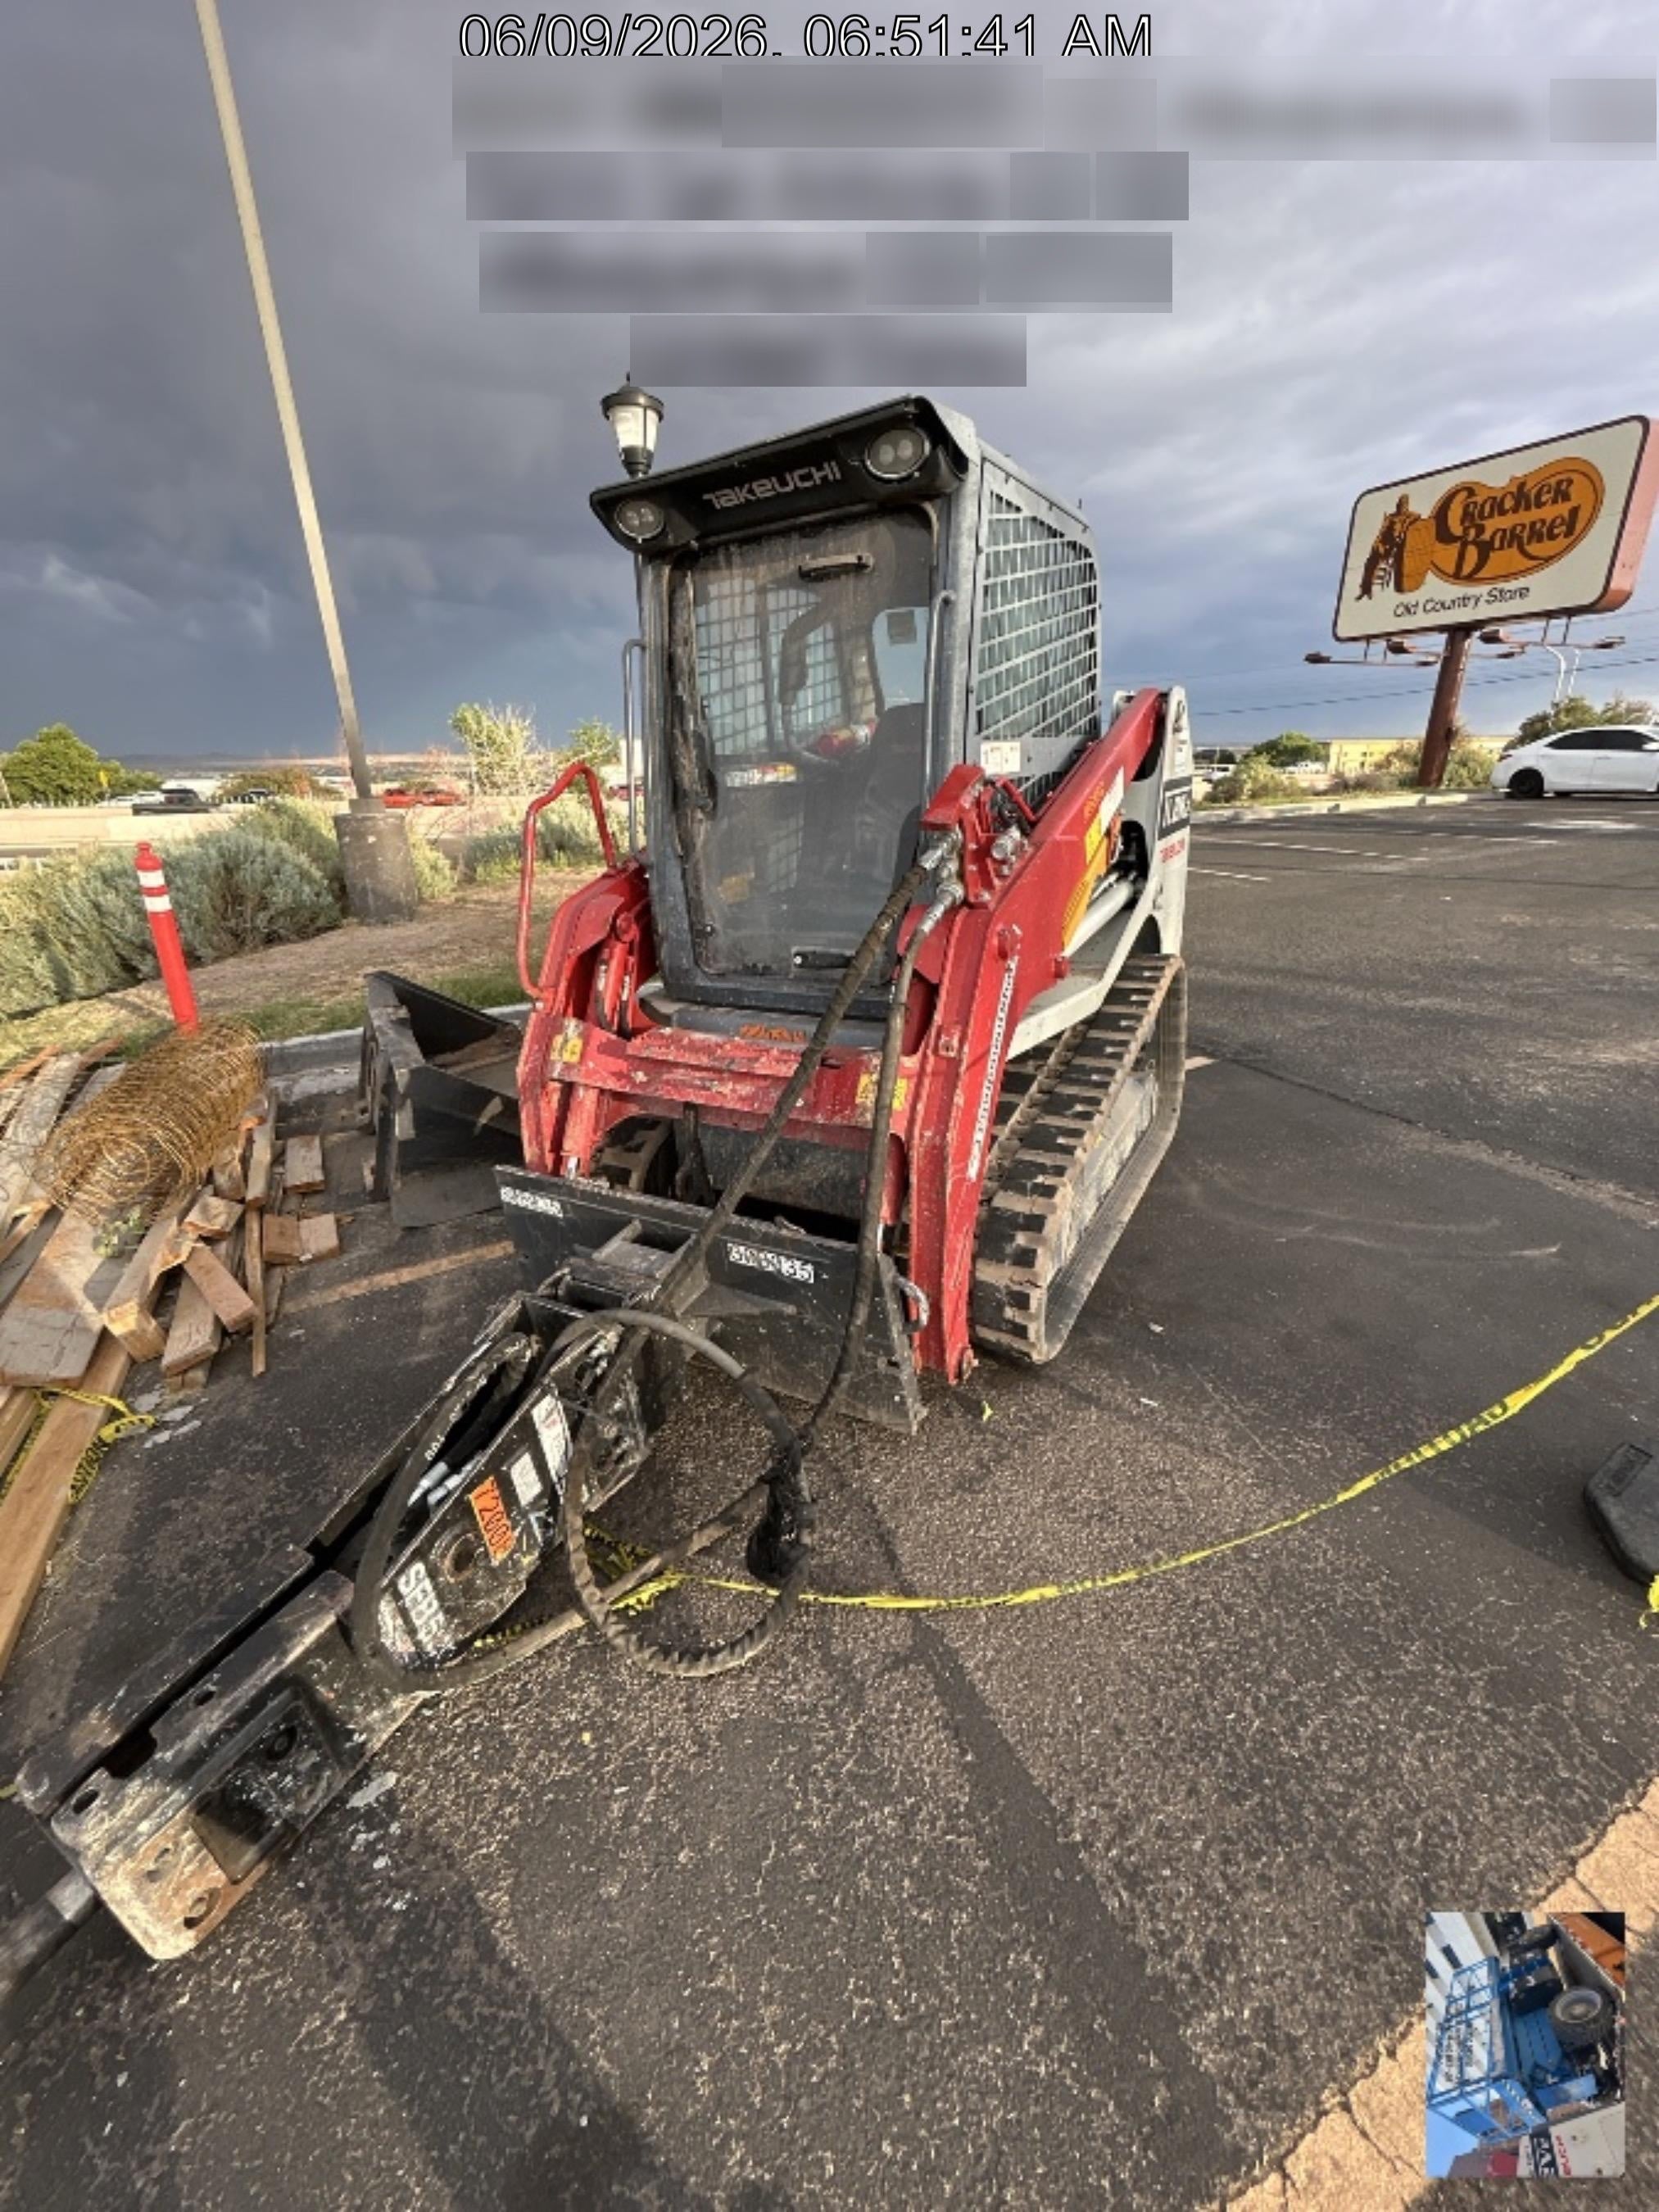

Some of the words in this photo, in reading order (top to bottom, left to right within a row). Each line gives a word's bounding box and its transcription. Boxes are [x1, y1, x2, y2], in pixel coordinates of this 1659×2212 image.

[1454, 504, 1582, 579] Barrel
[1394, 599, 1419, 618] Old
[1422, 592, 1483, 614] Country
[1484, 586, 1530, 605] Store
